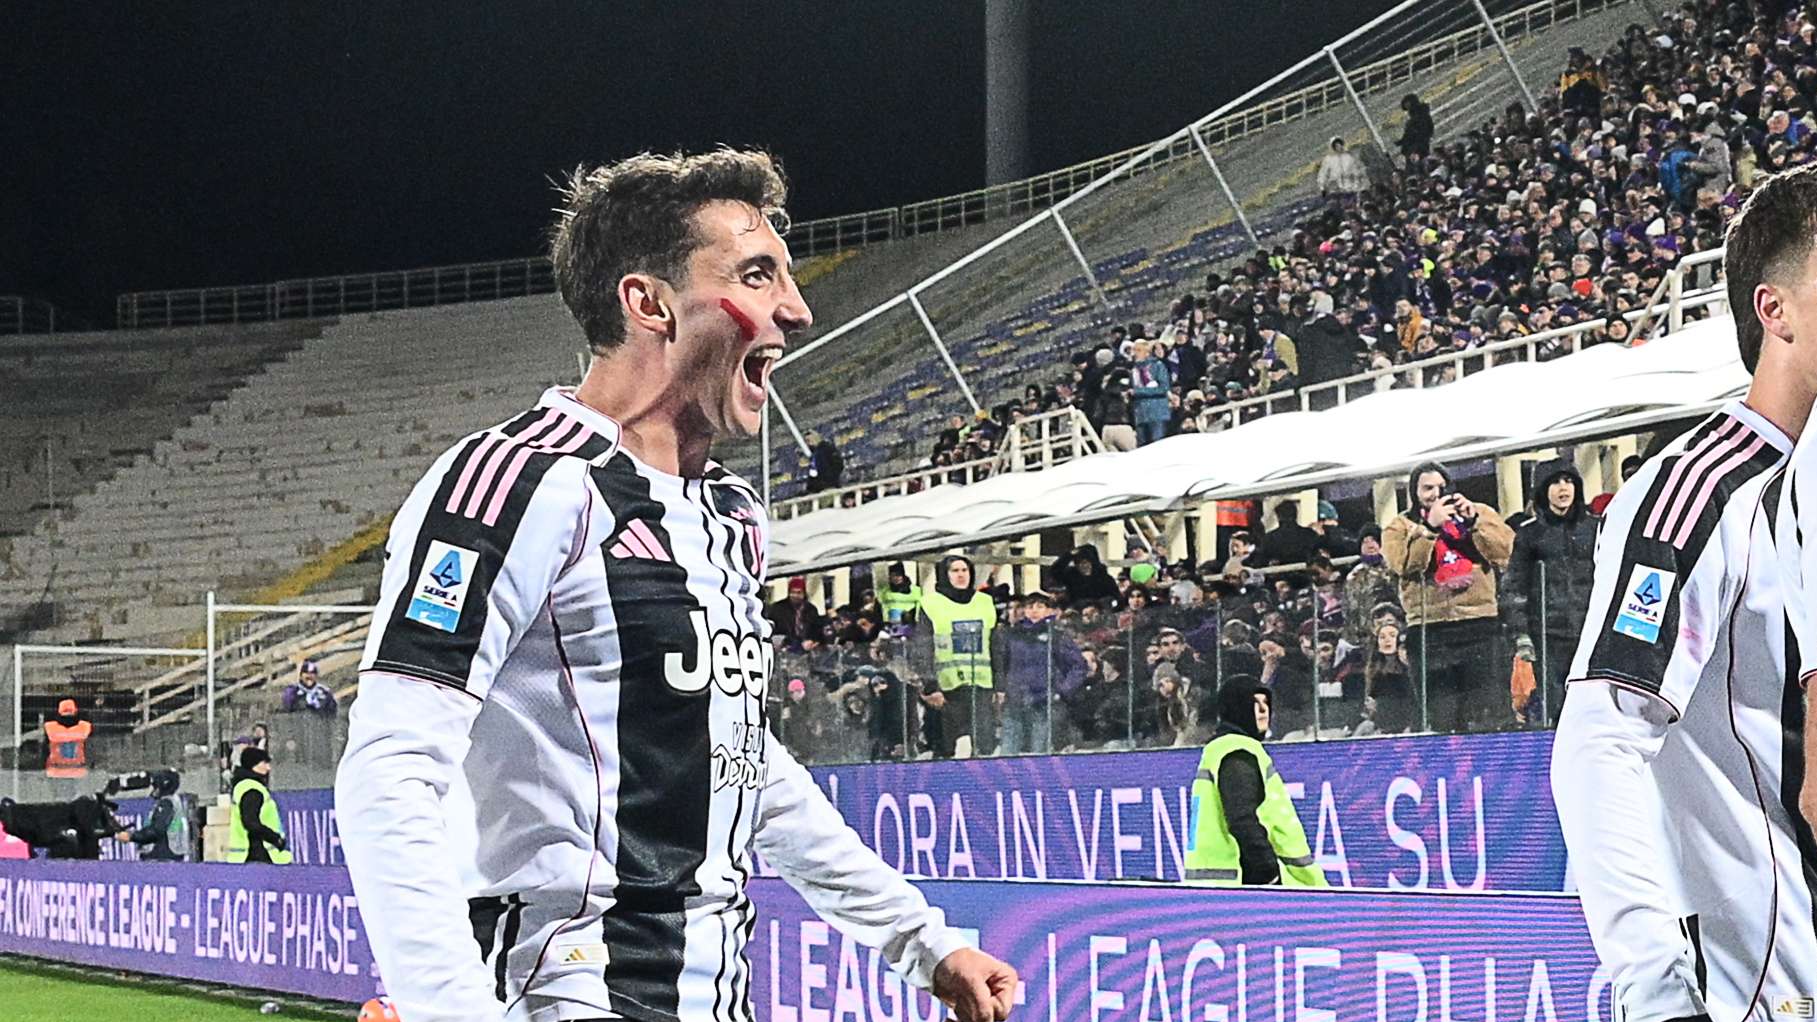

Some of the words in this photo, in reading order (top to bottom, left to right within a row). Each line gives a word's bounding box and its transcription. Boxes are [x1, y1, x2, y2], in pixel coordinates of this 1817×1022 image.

[873, 790, 977, 880] ORA
[996, 790, 1048, 880] IN
[1385, 775, 1487, 892] SU
[15, 881, 105, 947] CONFERENCE
[109, 884, 178, 954] LEAGUE
[194, 887, 278, 966] LEAGUE
[282, 891, 360, 977] PHASE
